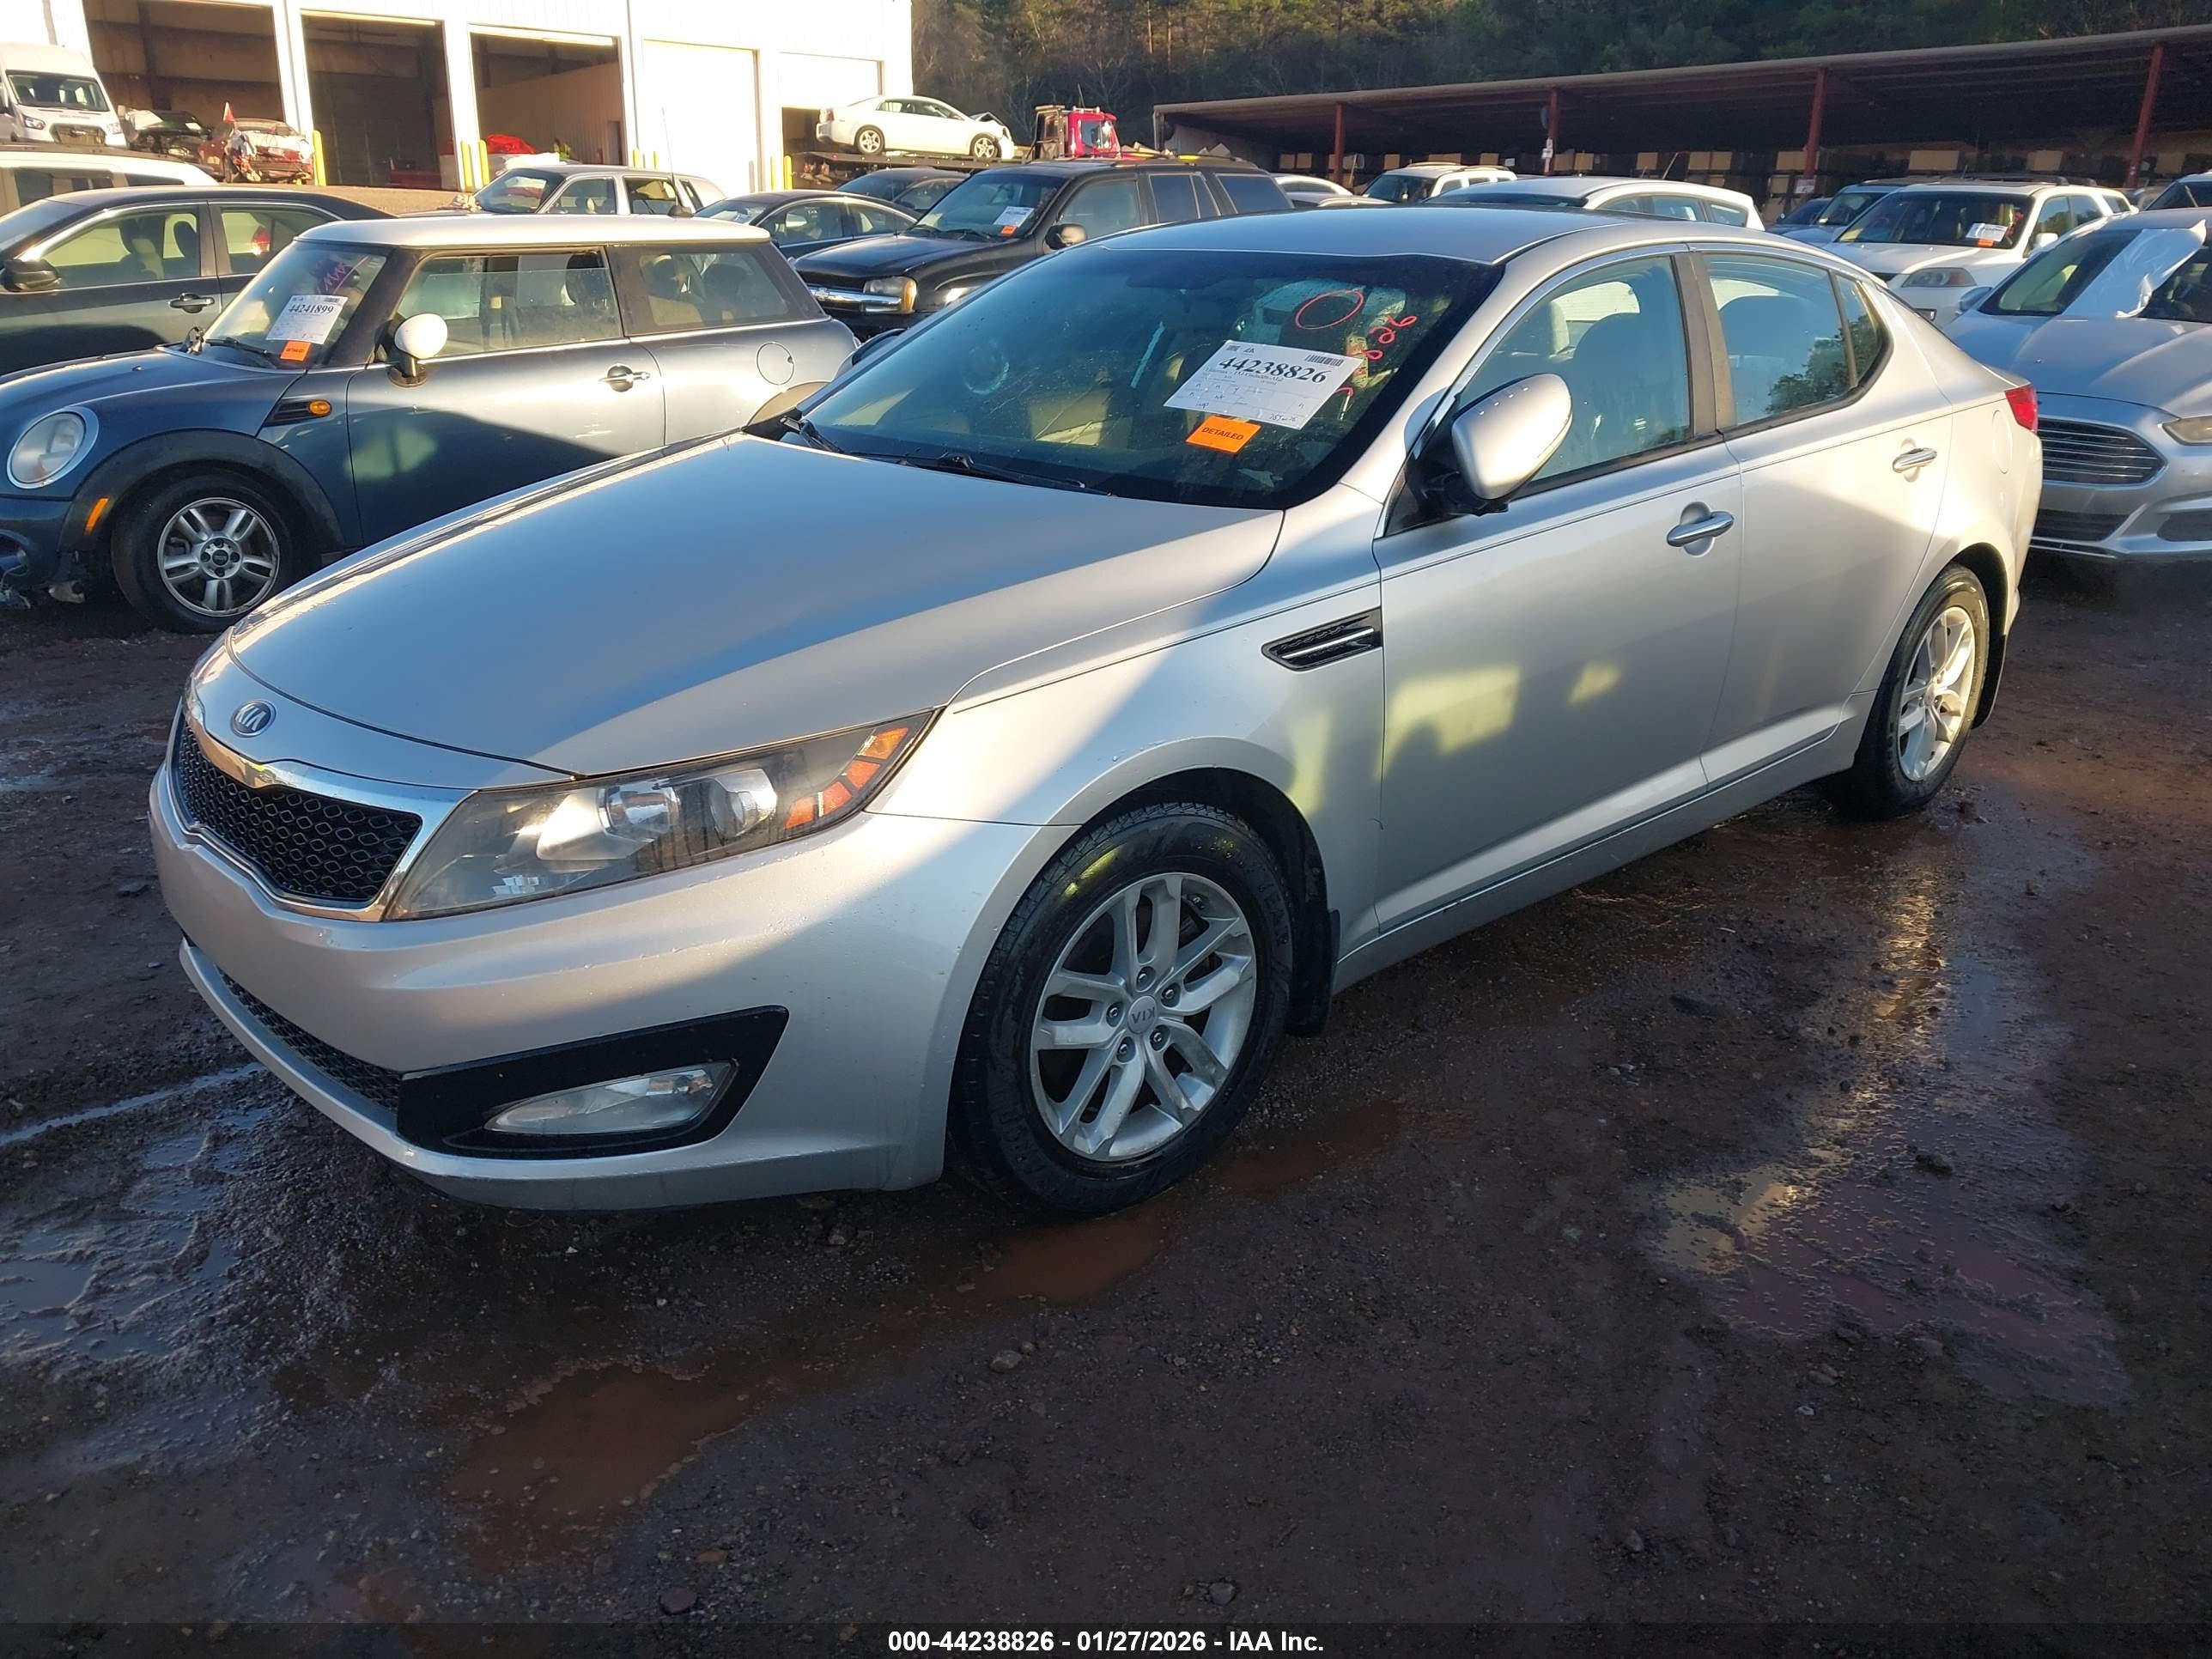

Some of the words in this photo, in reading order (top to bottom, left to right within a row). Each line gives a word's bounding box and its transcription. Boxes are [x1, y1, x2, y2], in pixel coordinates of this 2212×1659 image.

[1218, 356, 1333, 385] 44238826
[1201, 427, 1244, 441] DETAILED
[1132, 1006, 1155, 1024] KIA
